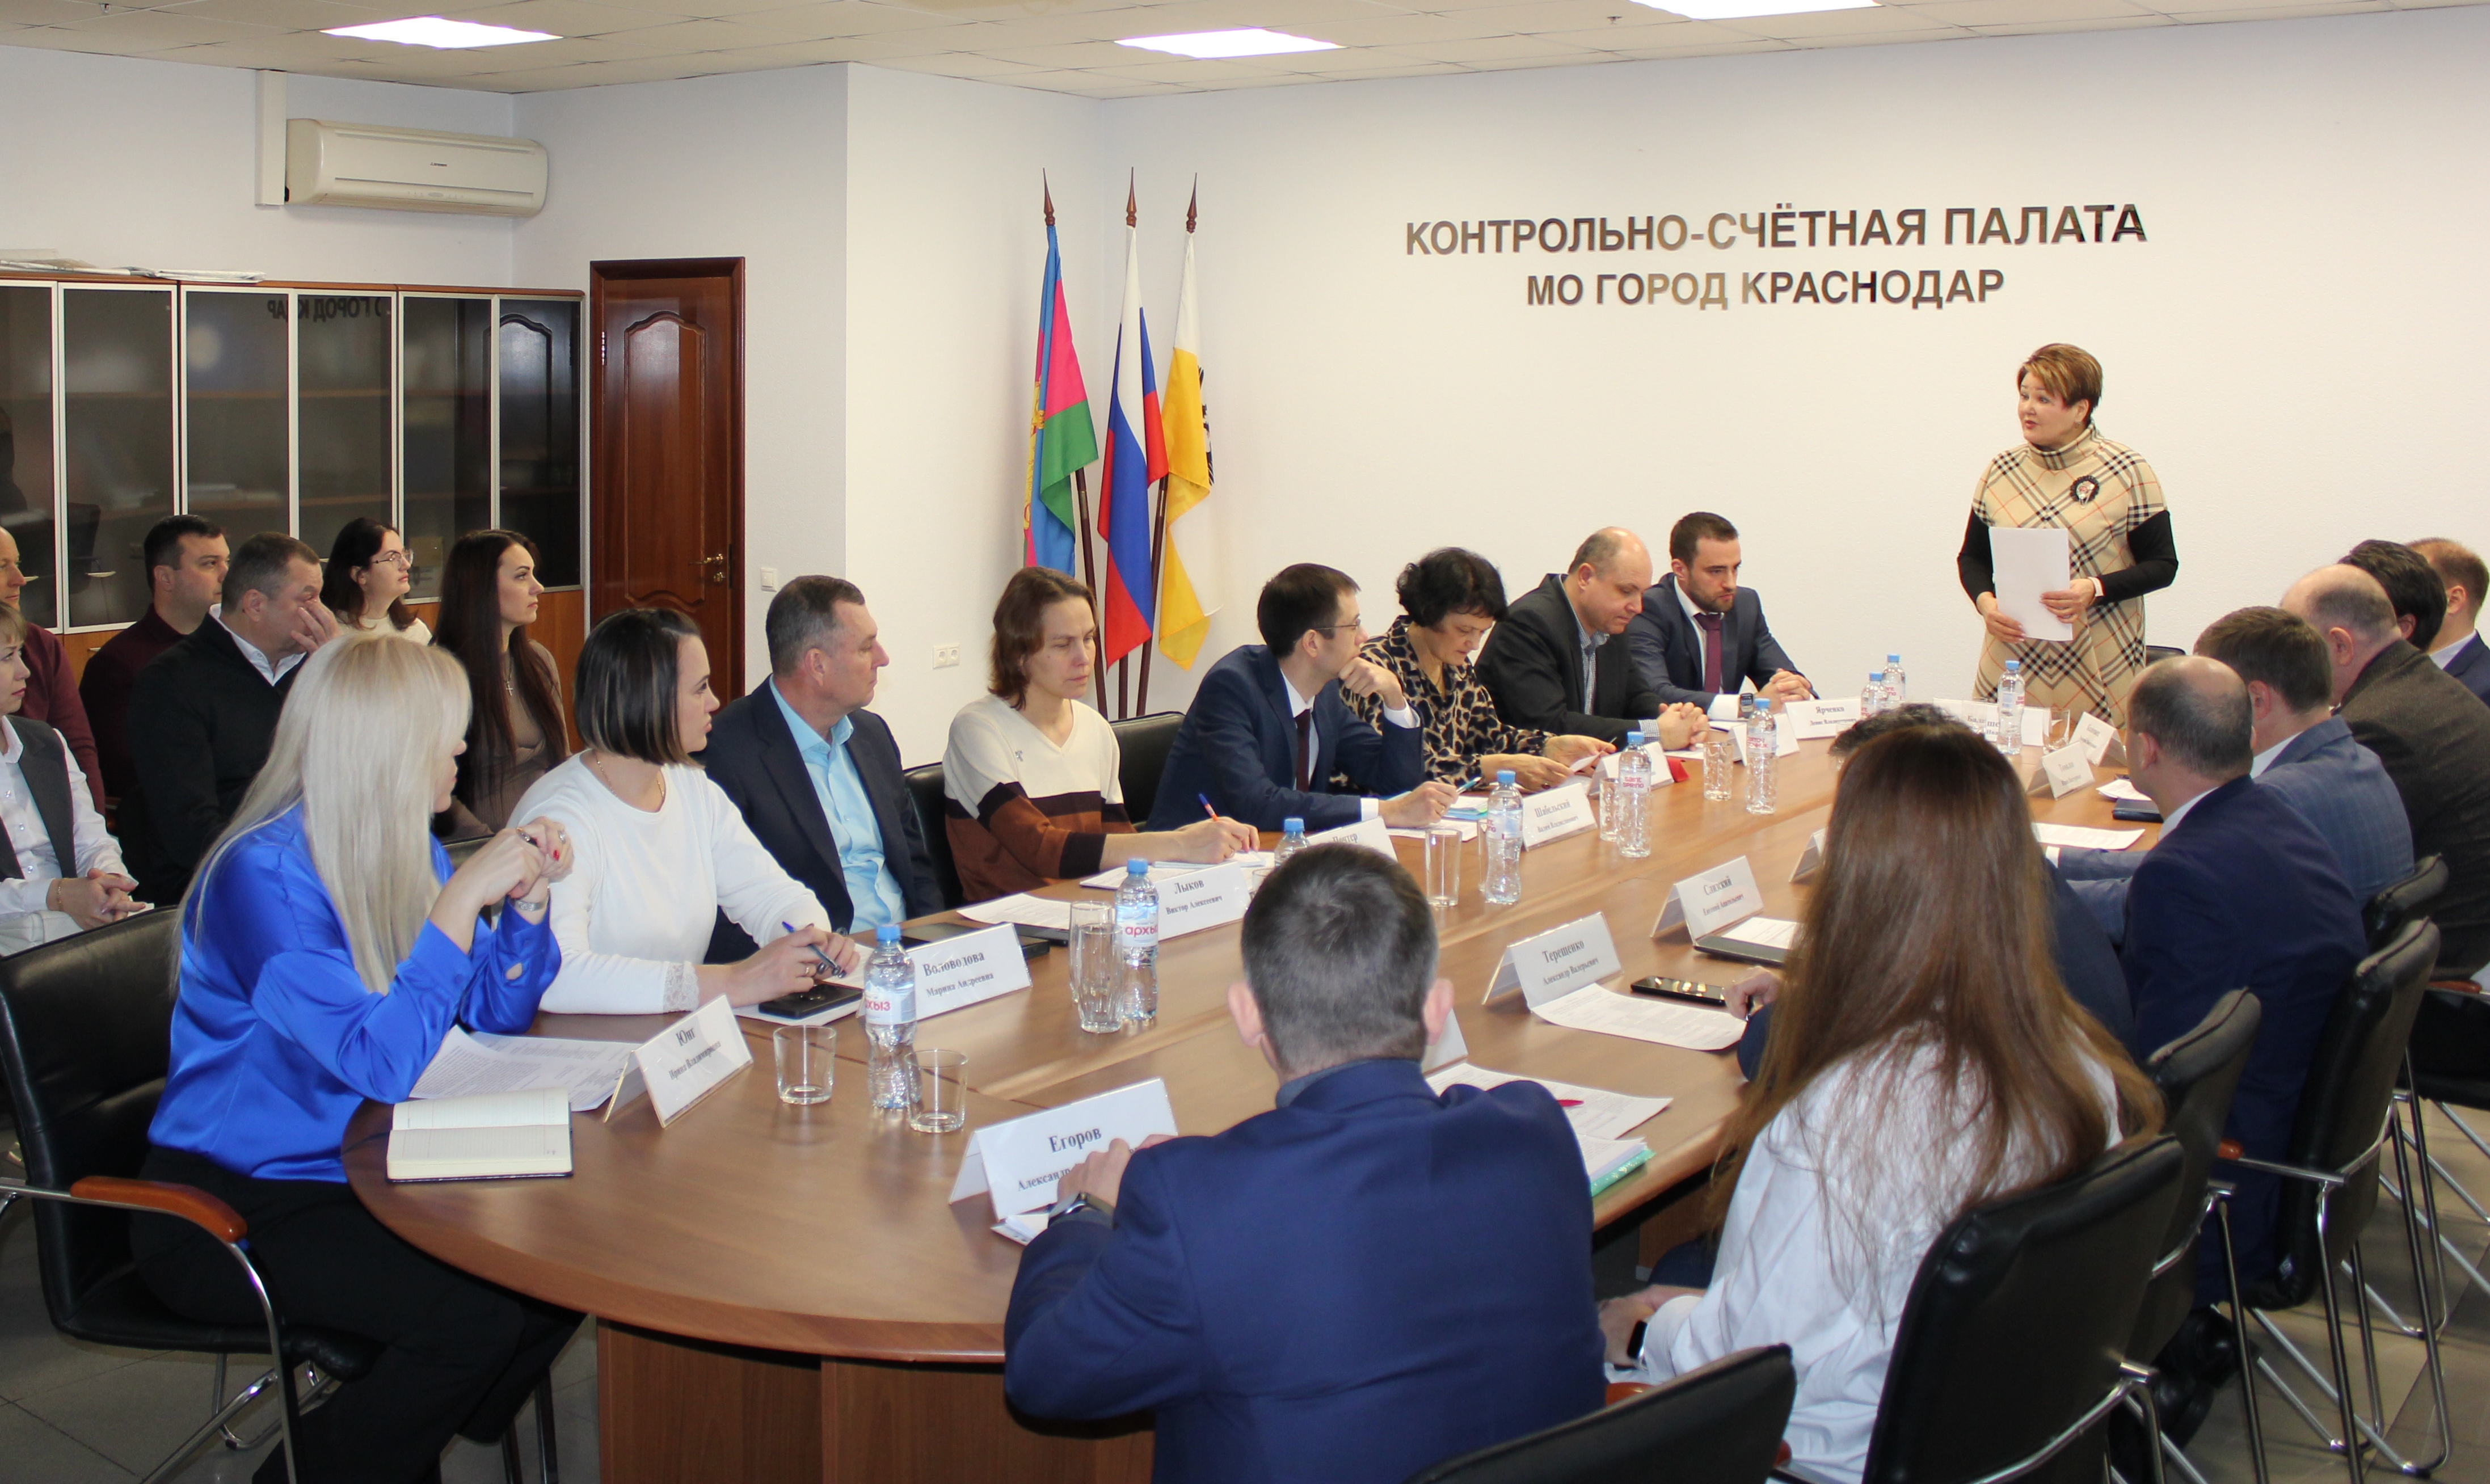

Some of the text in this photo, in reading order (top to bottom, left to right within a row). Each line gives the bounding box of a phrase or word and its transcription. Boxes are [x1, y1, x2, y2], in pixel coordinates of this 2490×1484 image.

[1406, 203, 2148, 256] КОНТРОЛЬНО-СЧЁТНАЯ ПАЛАТА
[1527, 269, 2005, 311] МО ГОРОД КРАСНОДАР
[1174, 879, 1204, 895] Лыков
[1166, 895, 1223, 915] Виктор Алексеевич
[1542, 940, 1585, 963] Терещенко
[923, 951, 985, 977] Воловодова
[926, 973, 994, 998] Марина Андреевна
[1543, 969, 1571, 986] Александр
[676, 1028, 696, 1047] Юнг
[1048, 1128, 1102, 1153] Егоров
